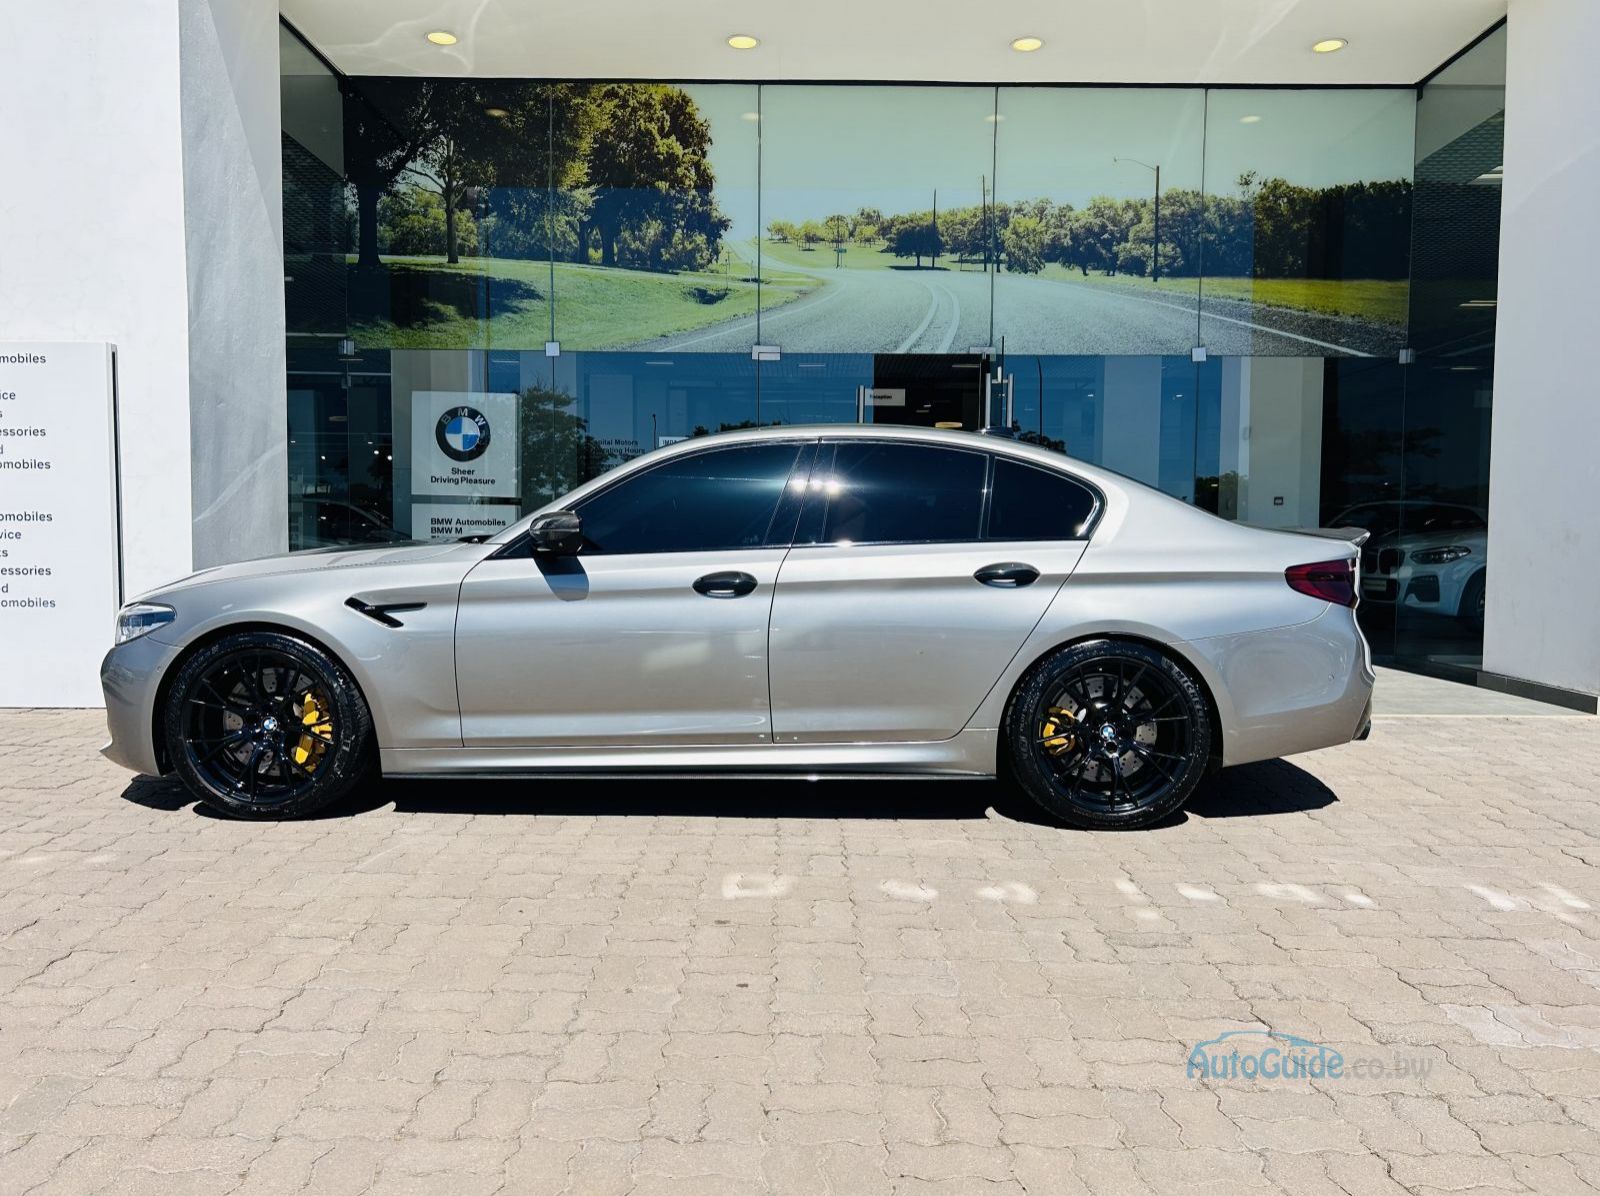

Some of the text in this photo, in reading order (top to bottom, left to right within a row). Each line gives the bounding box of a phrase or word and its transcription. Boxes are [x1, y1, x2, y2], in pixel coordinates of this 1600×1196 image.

[441, 408, 486, 426] BMW
[0, 426, 46, 437] ssories
[451, 467, 475, 476] Sheer
[430, 476, 496, 485] Driving Pleasure
[430, 518, 506, 526] BMW Automobiles
[430, 527, 463, 535] BMW M
[0, 597, 56, 608] omobiles
